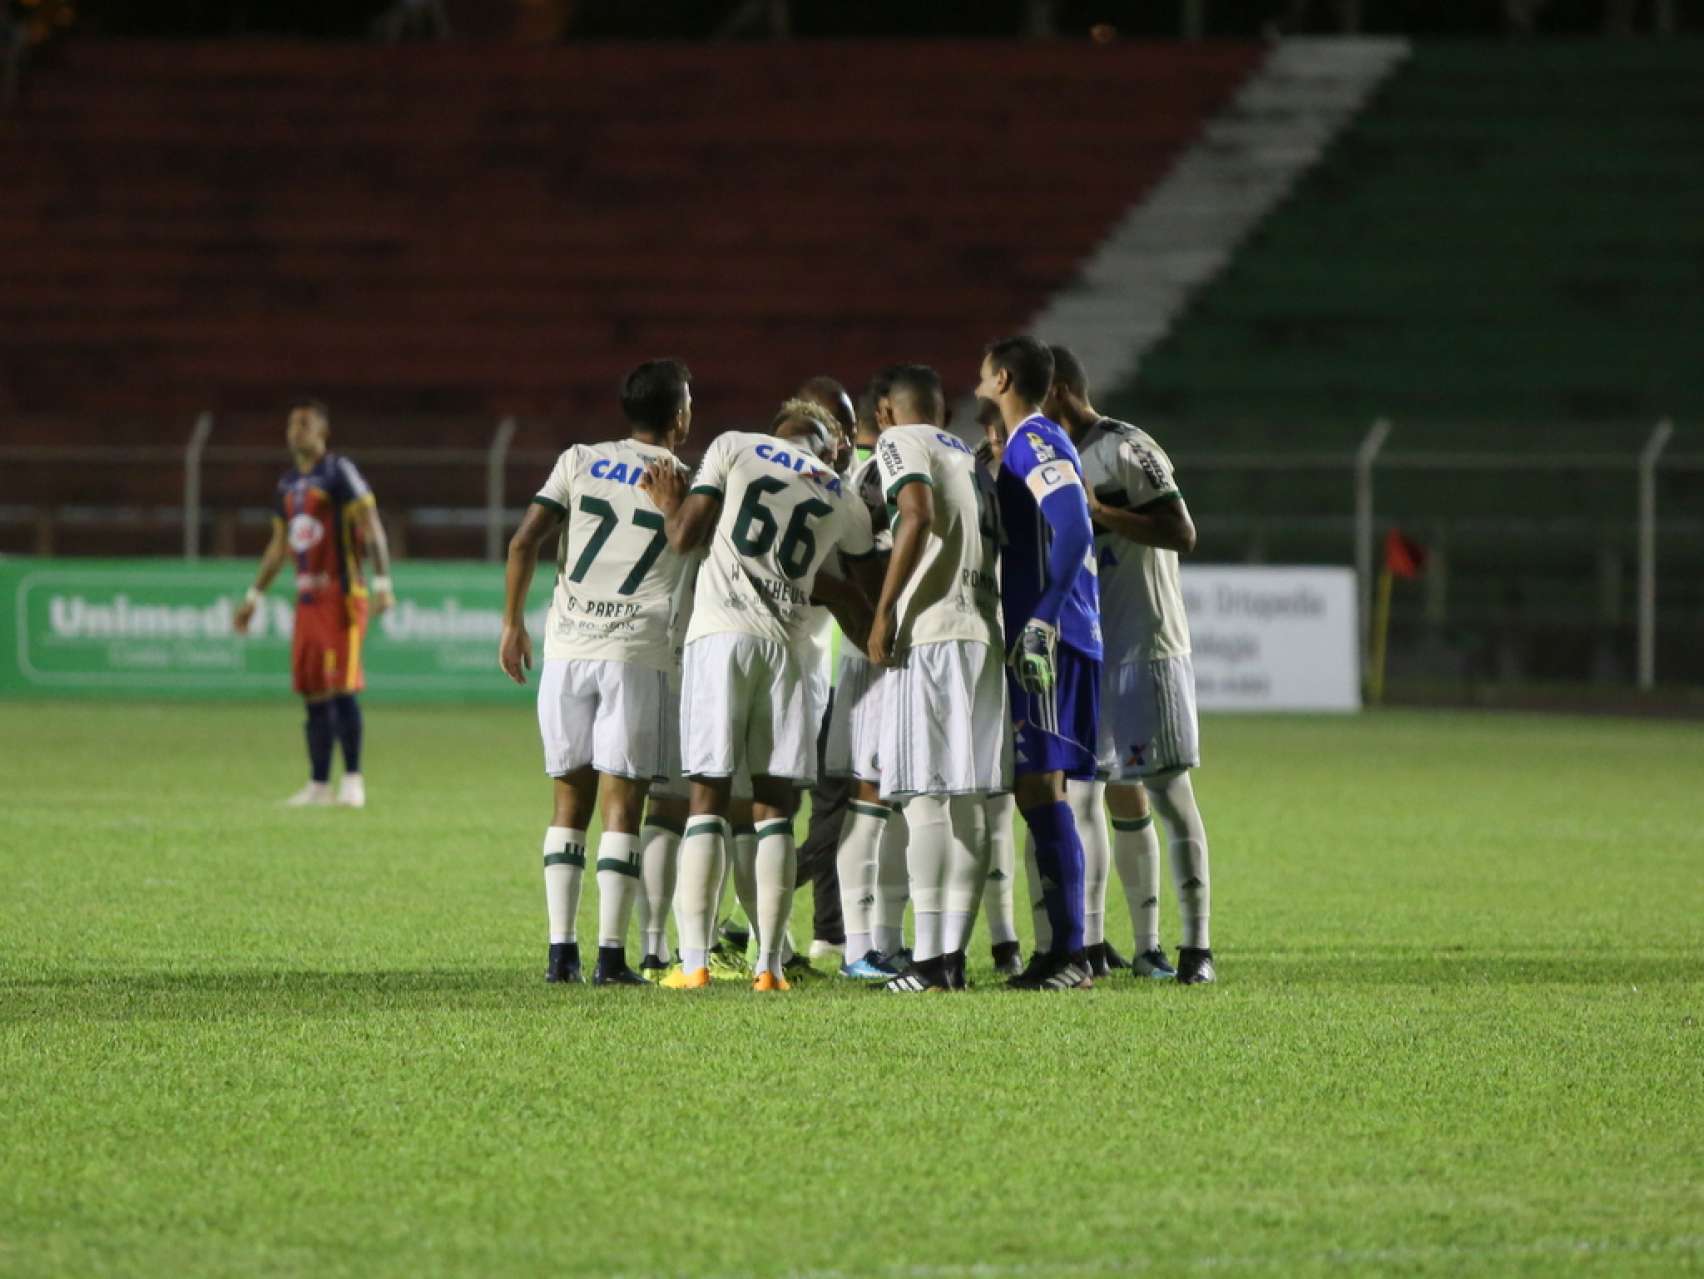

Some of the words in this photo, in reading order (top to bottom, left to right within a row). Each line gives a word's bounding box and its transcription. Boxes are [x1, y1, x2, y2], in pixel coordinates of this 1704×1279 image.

[590, 459, 643, 486] CAI
[755, 444, 842, 498] CAIXA
[1041, 466, 1061, 486] C
[568, 494, 668, 596] 77
[731, 474, 833, 580] 66
[50, 596, 231, 637] Unimed
